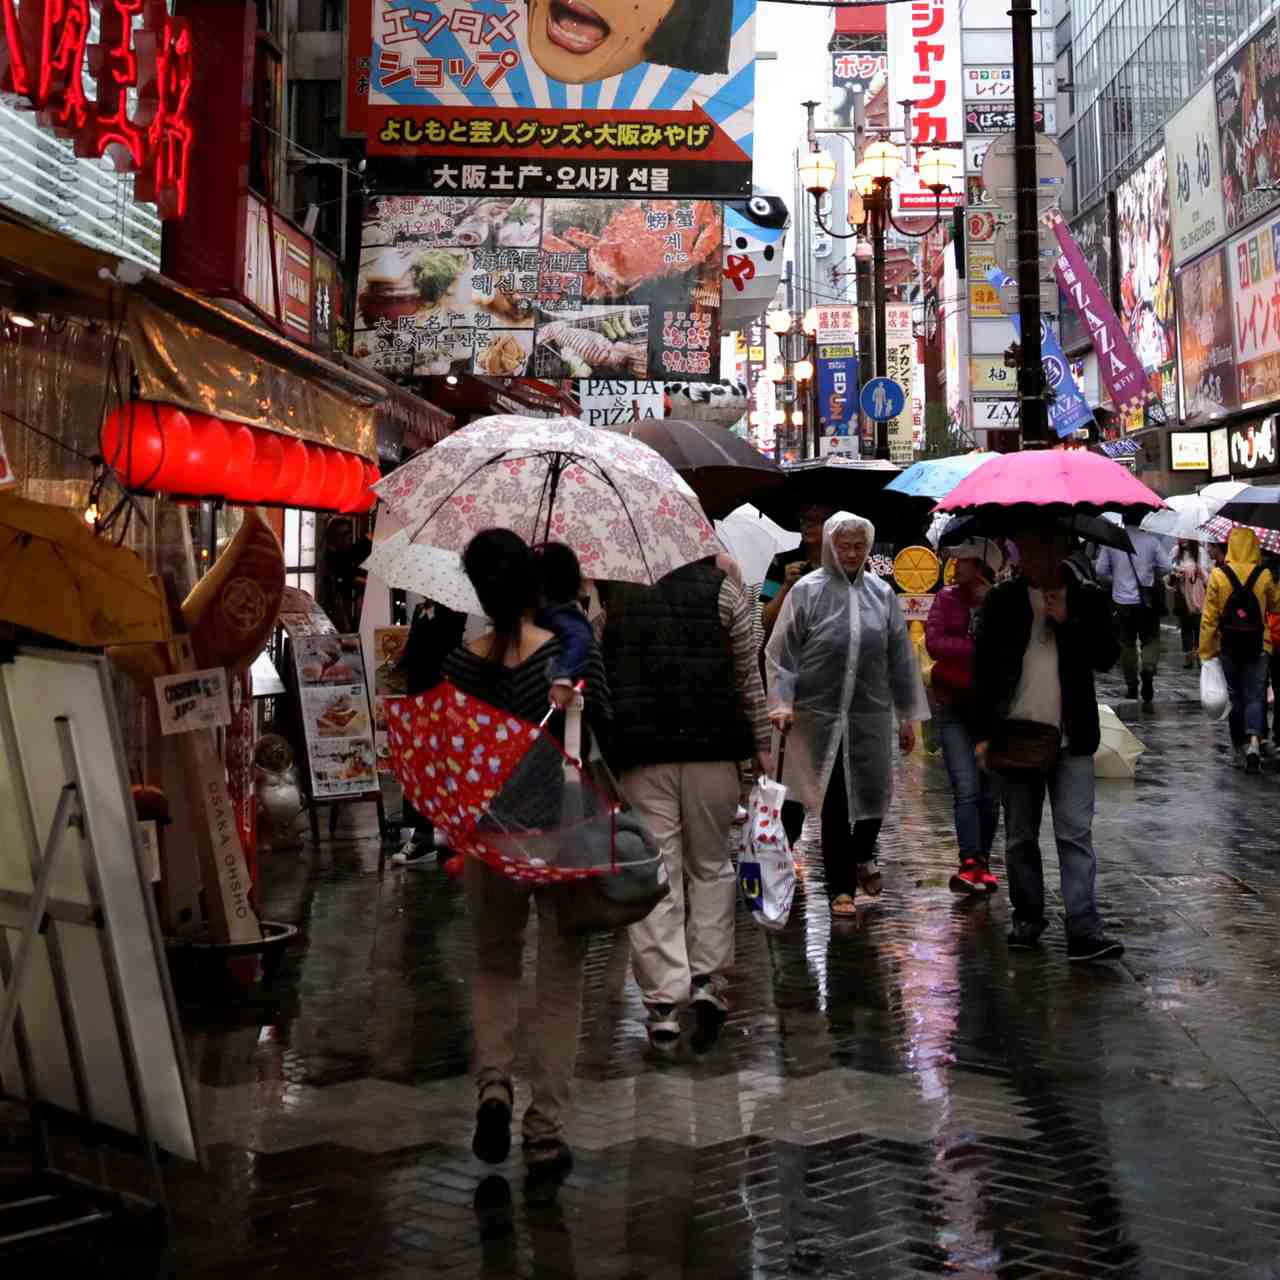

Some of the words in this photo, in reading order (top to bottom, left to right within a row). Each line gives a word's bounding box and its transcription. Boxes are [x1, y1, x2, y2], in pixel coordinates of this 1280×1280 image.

[381, 8, 521, 46] エンタメ
[378, 50, 520, 91] ショップ
[911, 0, 948, 188] ジャンカ
[378, 117, 710, 151] よしもと芸人グッズ・大阪みやげ
[628, 163, 670, 193] 선물
[1070, 281, 1127, 378] ZAZA
[586, 380, 660, 397] PASTA
